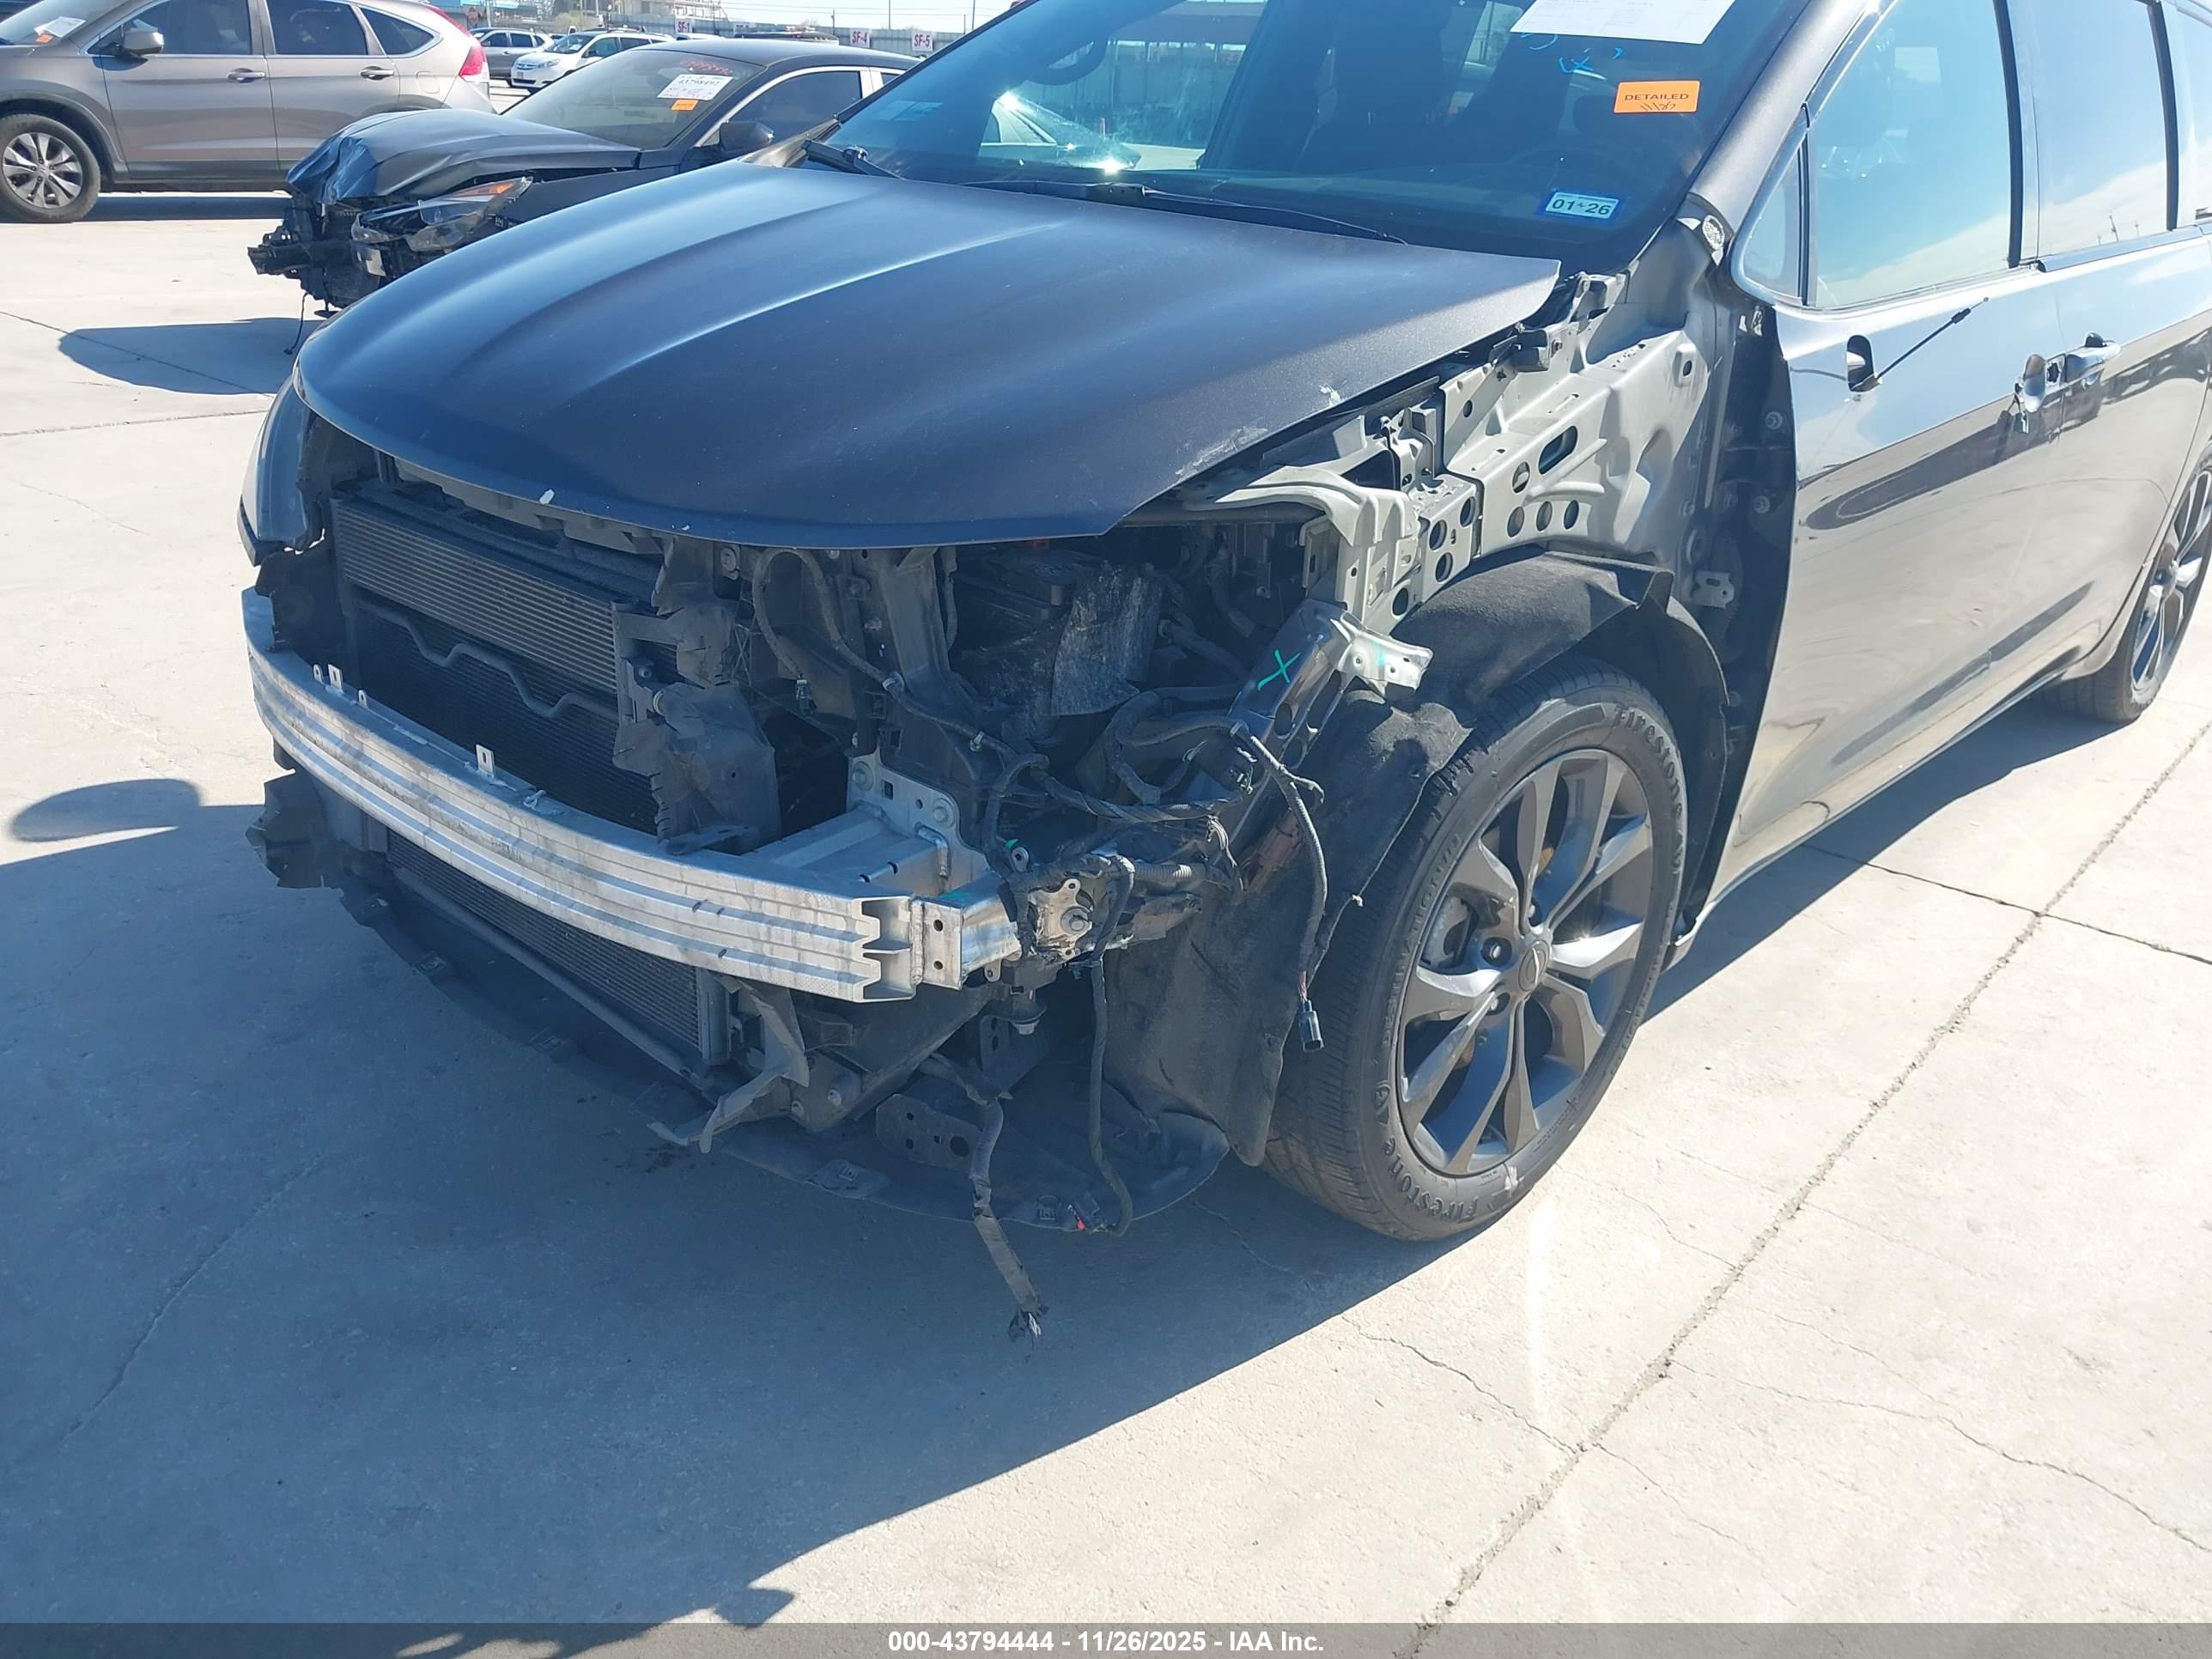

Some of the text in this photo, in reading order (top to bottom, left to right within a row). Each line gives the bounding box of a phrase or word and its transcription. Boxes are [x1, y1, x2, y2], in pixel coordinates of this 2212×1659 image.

[852, 31, 867, 44] SF-4
[914, 33, 931, 47] SF-5
[1552, 198, 1612, 216] 01 26
[1613, 703, 1684, 820] Firestone
[1384, 1136, 1480, 1223] Firestone
